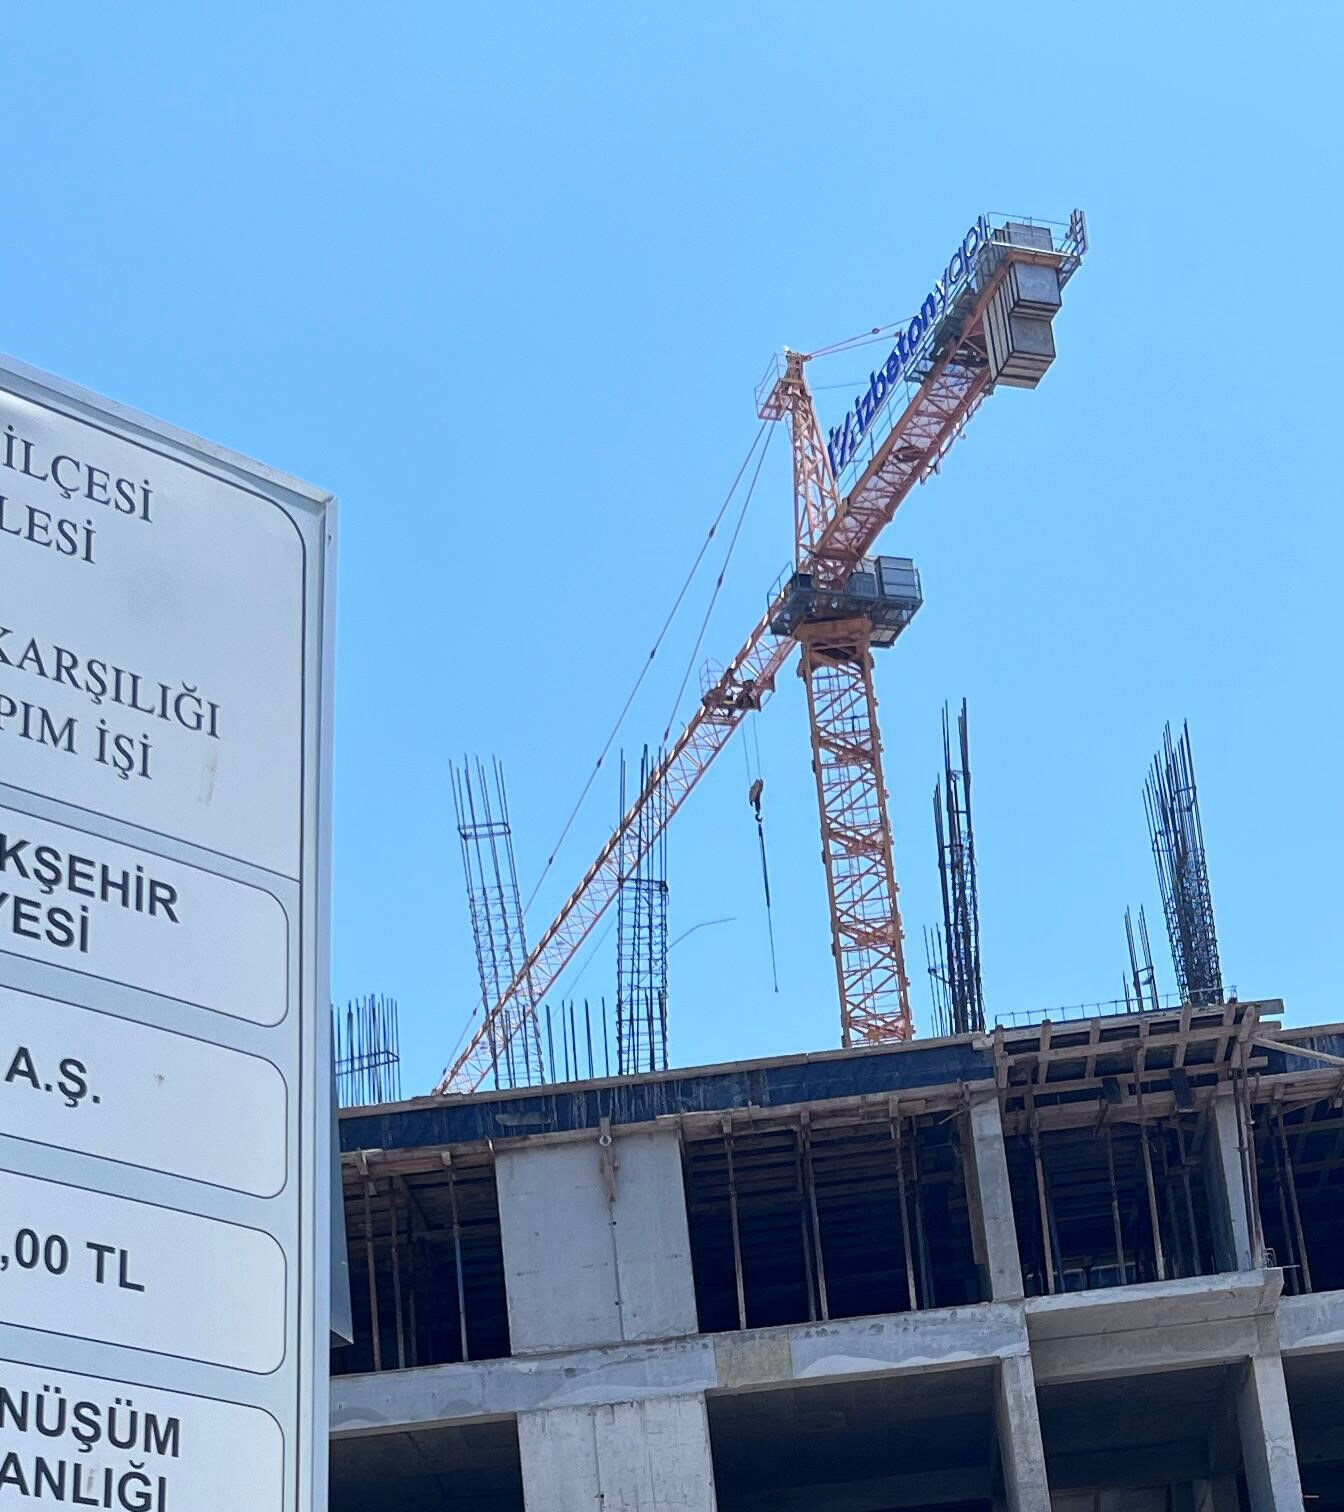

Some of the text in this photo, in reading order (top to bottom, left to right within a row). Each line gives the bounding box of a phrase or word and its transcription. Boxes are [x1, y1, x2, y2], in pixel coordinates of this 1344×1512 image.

[3, 424, 153, 523] İLÇESİ
[95, 718, 152, 780] İŞİ
[5, 1046, 100, 1108] A.Ş.
[86, 1242, 145, 1292] TL
